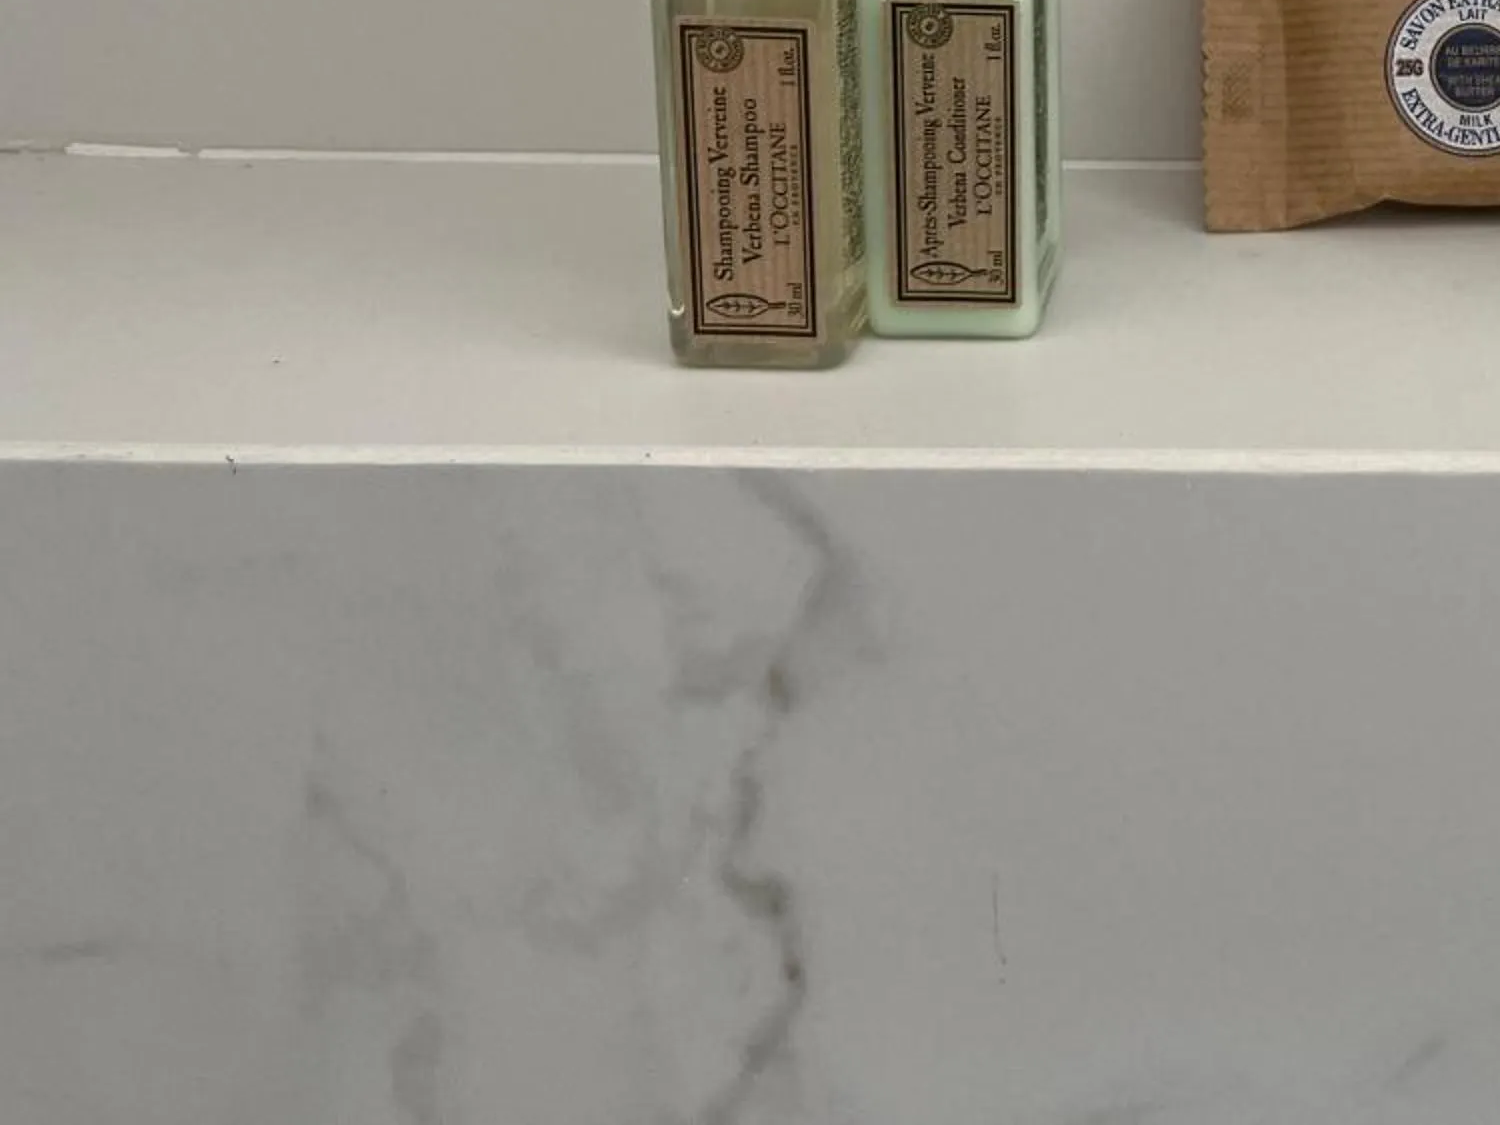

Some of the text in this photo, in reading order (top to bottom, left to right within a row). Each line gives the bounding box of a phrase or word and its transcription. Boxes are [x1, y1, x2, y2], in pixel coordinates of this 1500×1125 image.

[1457, 8, 1489, 22] LAIT
[914, 53, 936, 116] Verveine
[1395, 58, 1424, 76] 25G
[707, 86, 729, 165] Verveine
[946, 77, 967, 229] Verbena Conditioner
[973, 95, 992, 216] L'OCCITANE
[1459, 114, 1493, 127] MILK
[711, 166, 738, 282] Shampooing
[740, 98, 767, 265] Verbena Shampoo
[769, 123, 791, 246] L'OCCITANE
